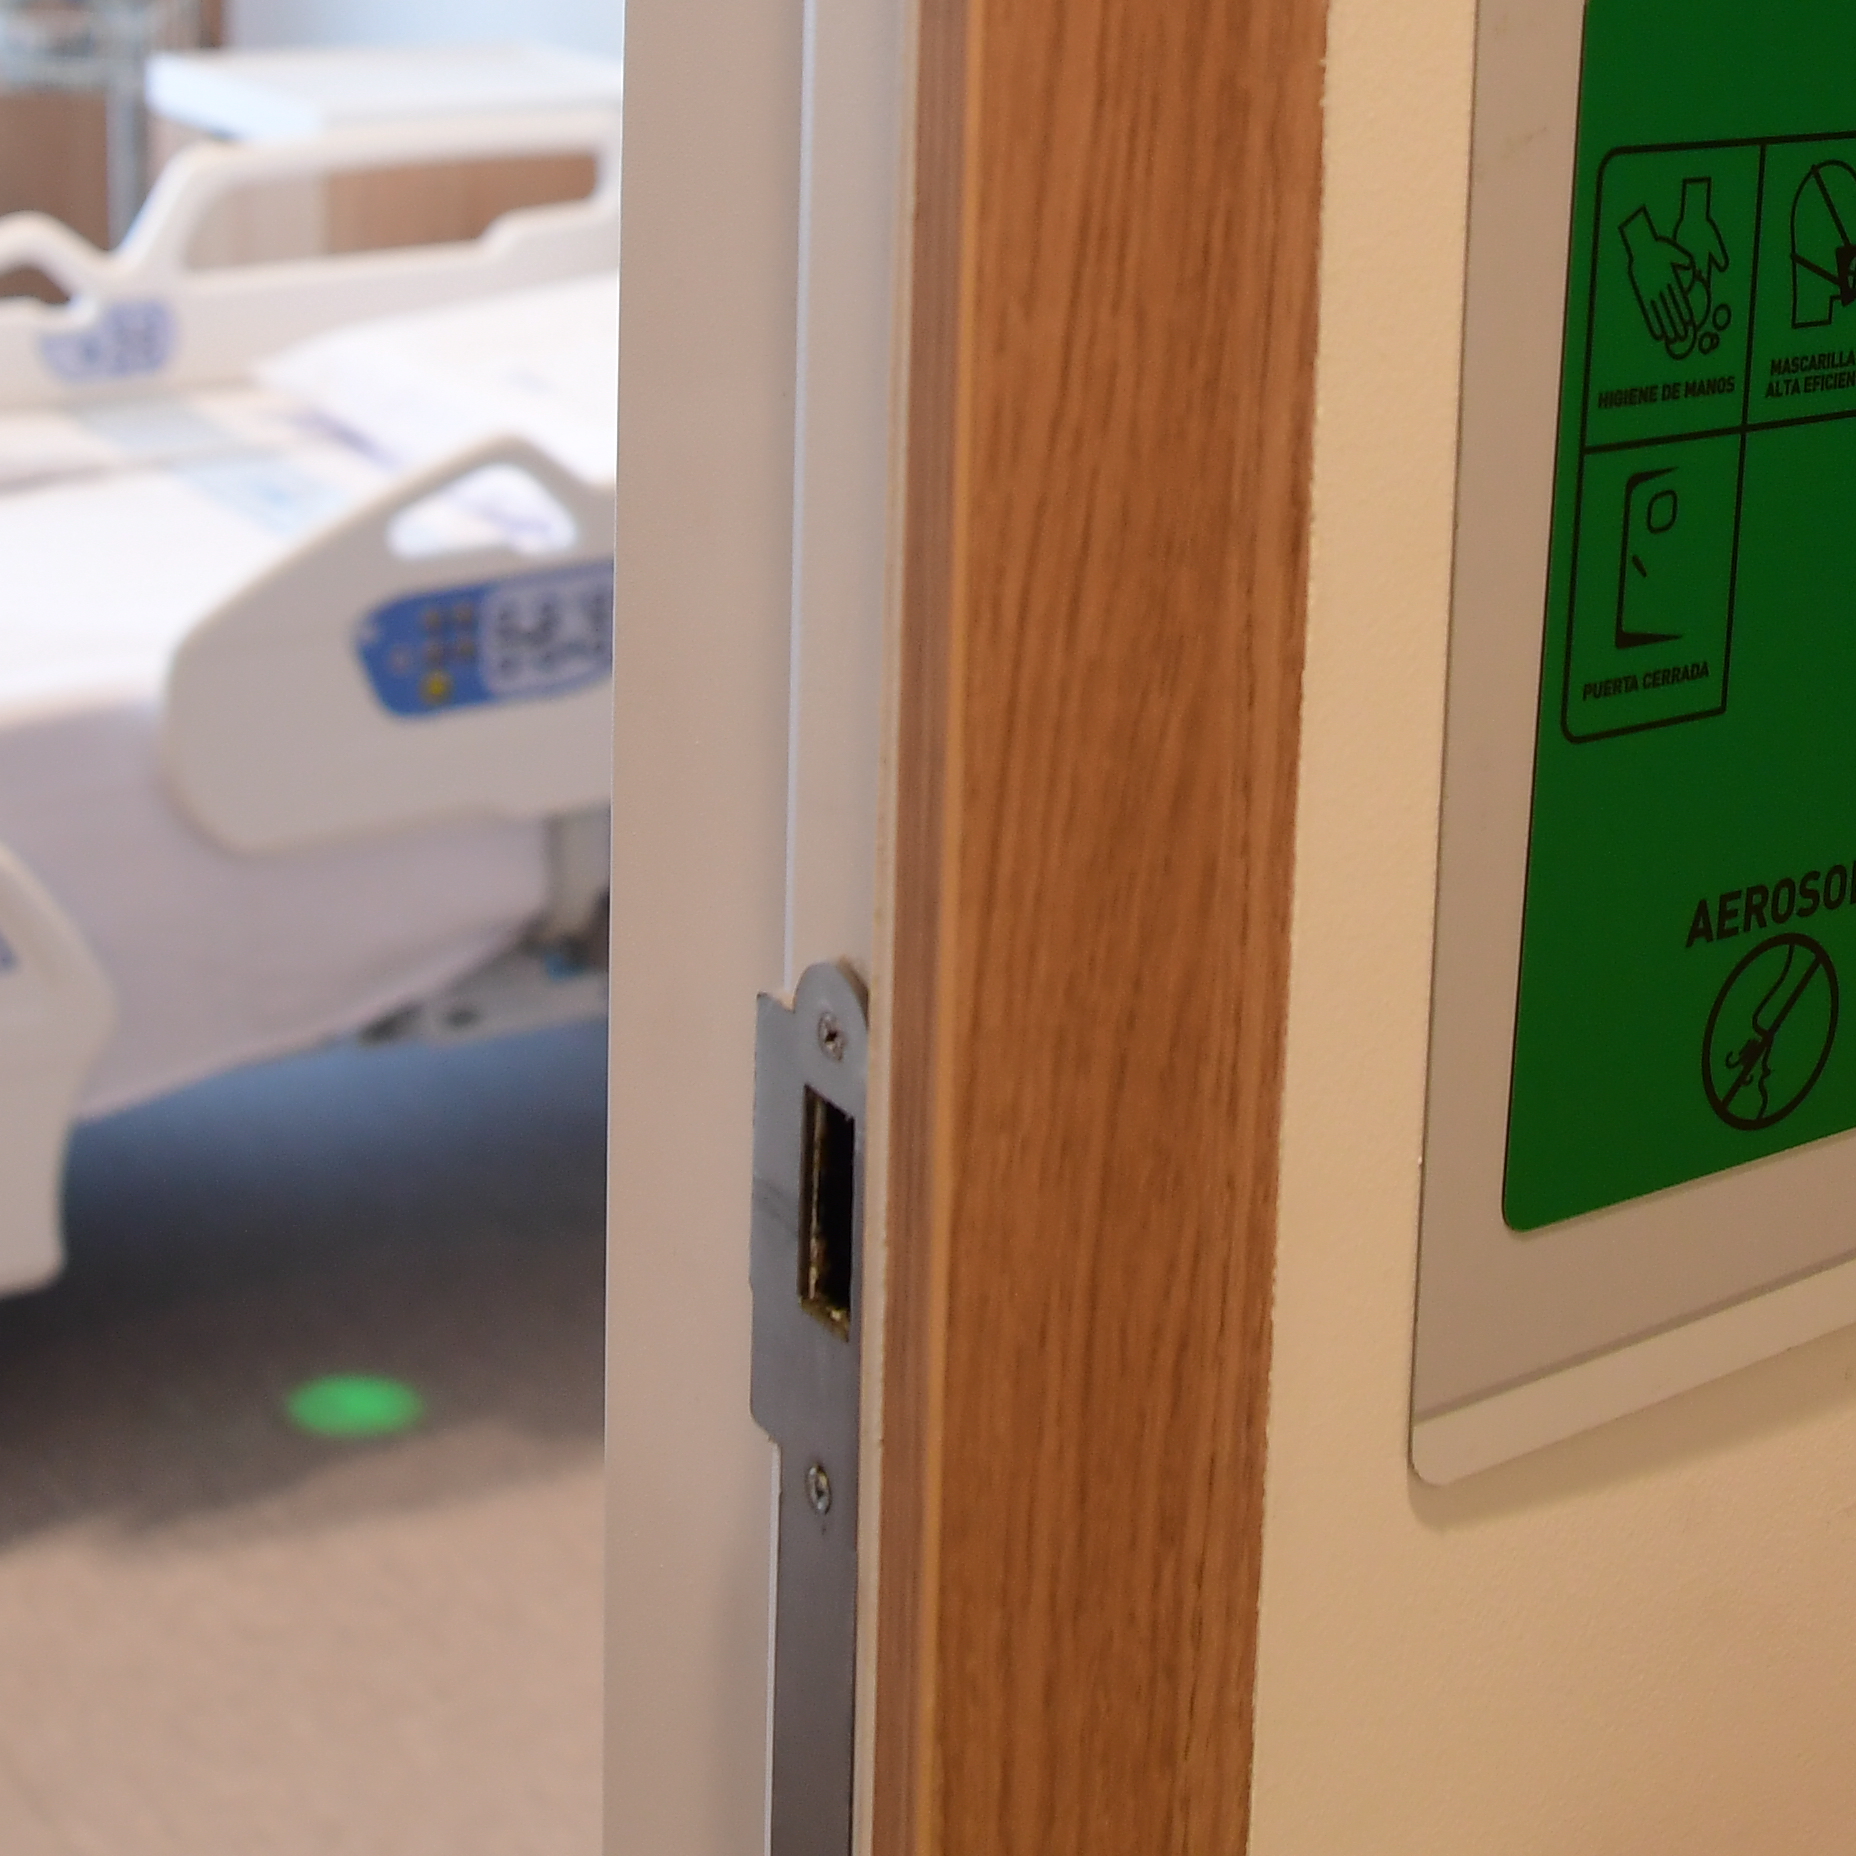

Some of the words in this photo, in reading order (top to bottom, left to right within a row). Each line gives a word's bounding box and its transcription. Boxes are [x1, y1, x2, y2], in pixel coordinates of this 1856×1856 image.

[1771, 350, 1855, 376] MASCARILLA
[1598, 385, 1658, 408] HIGIENE
[1662, 382, 1681, 401] DE
[1685, 375, 1735, 398] MANOS
[1765, 378, 1800, 398] ALTA
[1583, 674, 1638, 701] PUERTA
[1643, 661, 1709, 689] CERRADA
